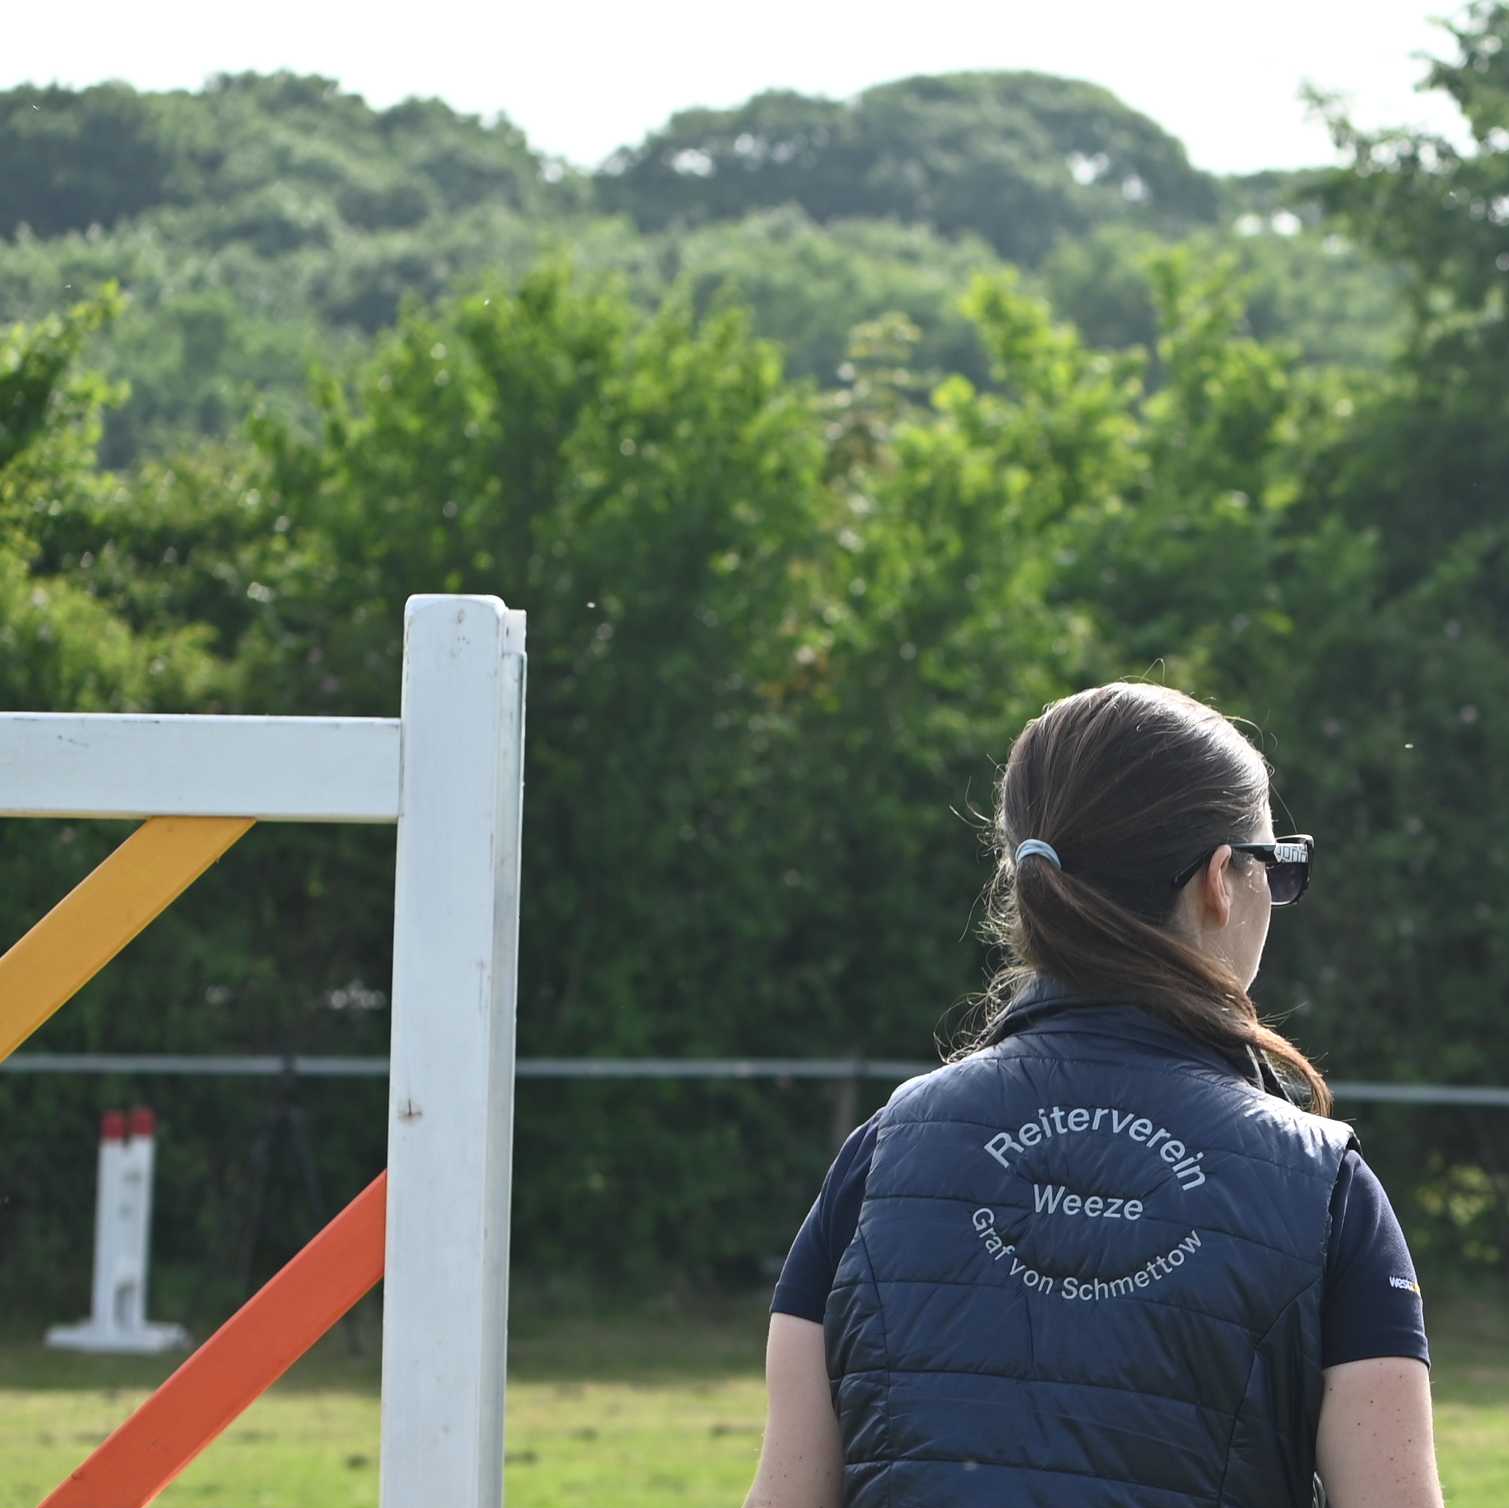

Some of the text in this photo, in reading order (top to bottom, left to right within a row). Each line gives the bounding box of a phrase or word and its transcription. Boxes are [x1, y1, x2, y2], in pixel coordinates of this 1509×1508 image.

[983, 1106, 1206, 1191] Reiterverein
[1033, 1183, 1144, 1221] Weeze
[972, 1207, 1202, 1301] Graf von Schmettow
